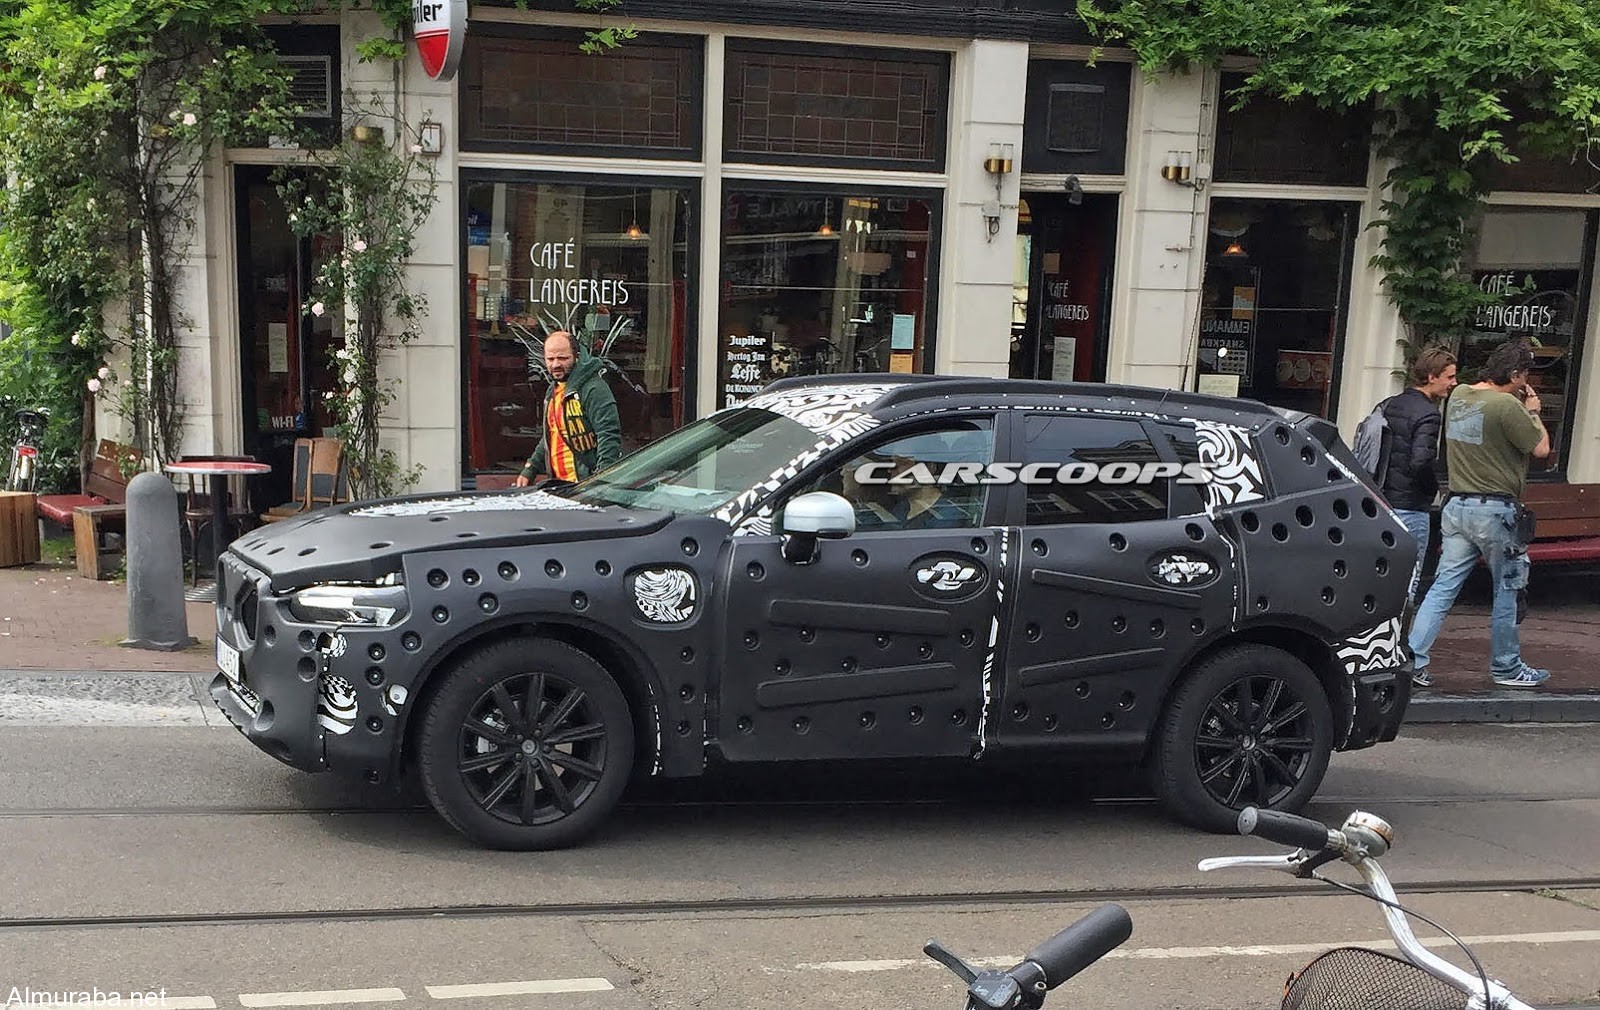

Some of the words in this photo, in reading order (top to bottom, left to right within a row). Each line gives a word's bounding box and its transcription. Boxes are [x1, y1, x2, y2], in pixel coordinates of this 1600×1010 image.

[530, 237, 575, 269] CAFÉ
[529, 278, 629, 305] LANGEREIS
[1479, 270, 1516, 297] CAFÉ
[729, 335, 767, 347] Jupiler
[730, 363, 762, 383] Leffe
[271, 415, 294, 428] WI-FI
